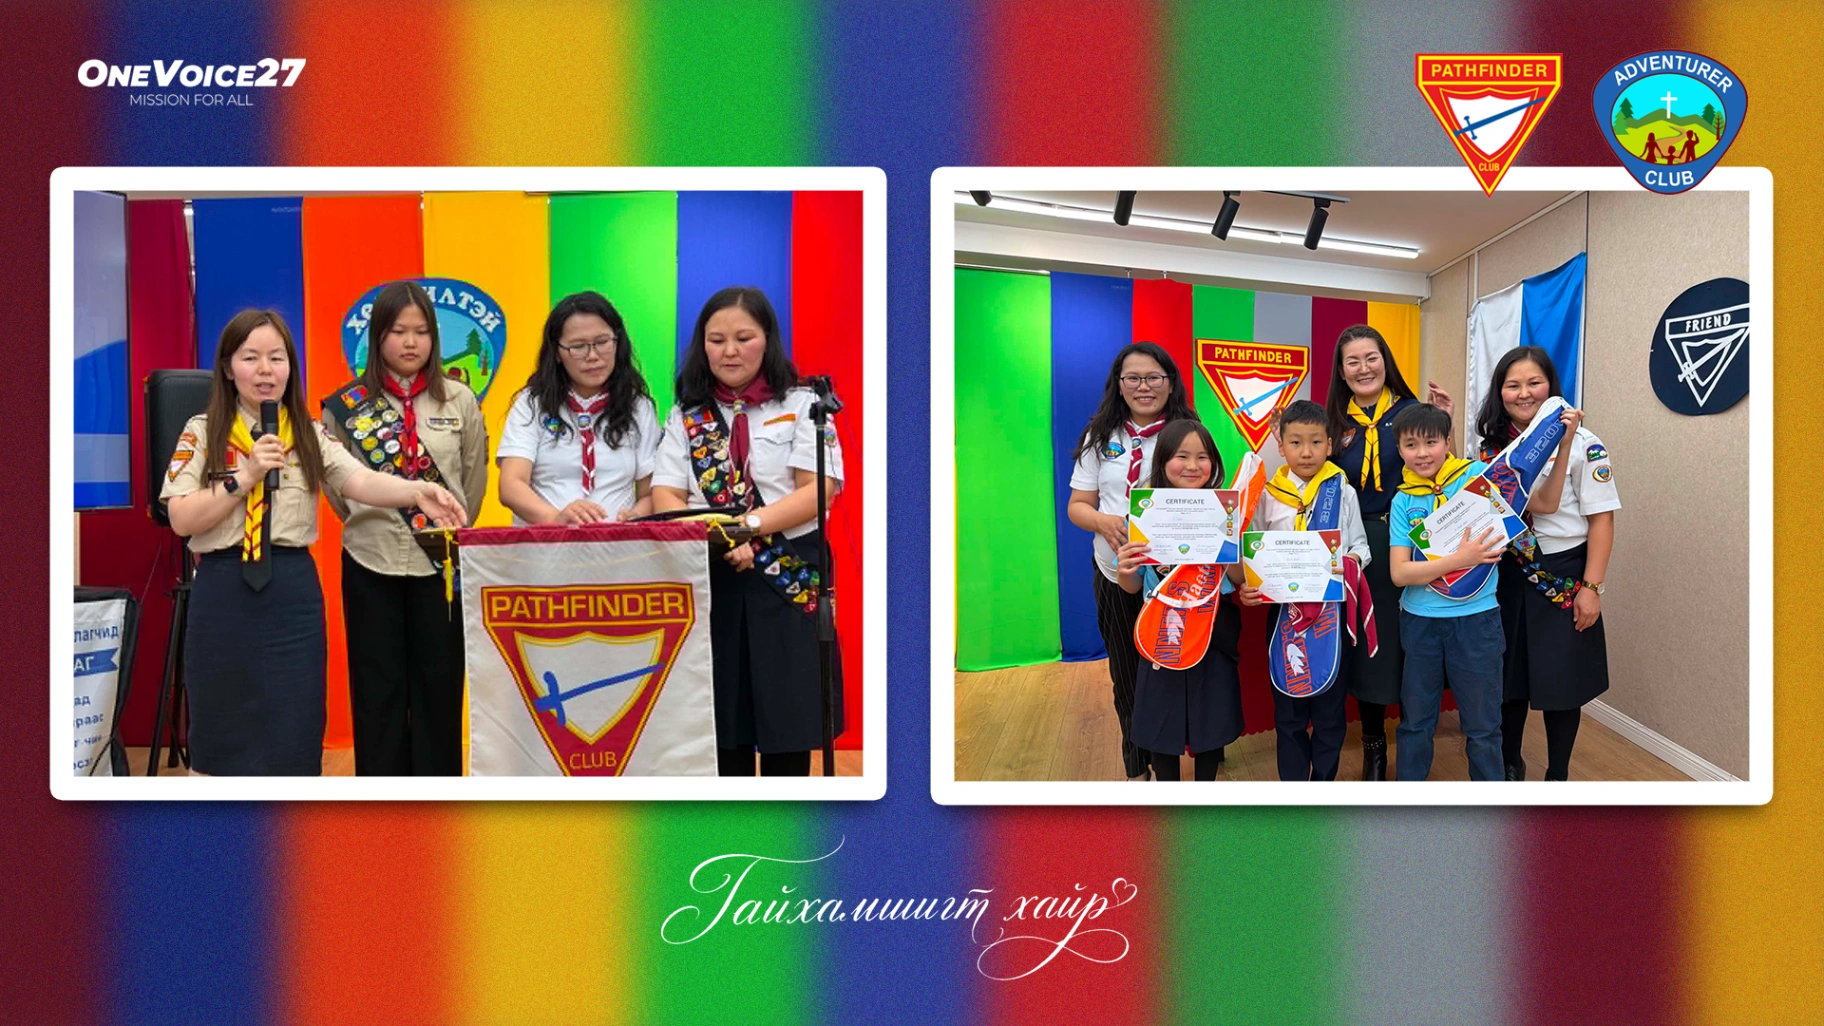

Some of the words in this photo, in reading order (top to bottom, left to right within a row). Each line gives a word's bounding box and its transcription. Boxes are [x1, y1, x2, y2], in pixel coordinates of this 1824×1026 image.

[1685, 313, 1731, 332] FRIEND
[1214, 346, 1292, 363] PATHFINDER
[1525, 418, 1563, 464] 320
[1436, 500, 1465, 525] CERTIFICATE
[491, 592, 685, 619] PATHFINDER
[569, 751, 618, 770] CLUB
